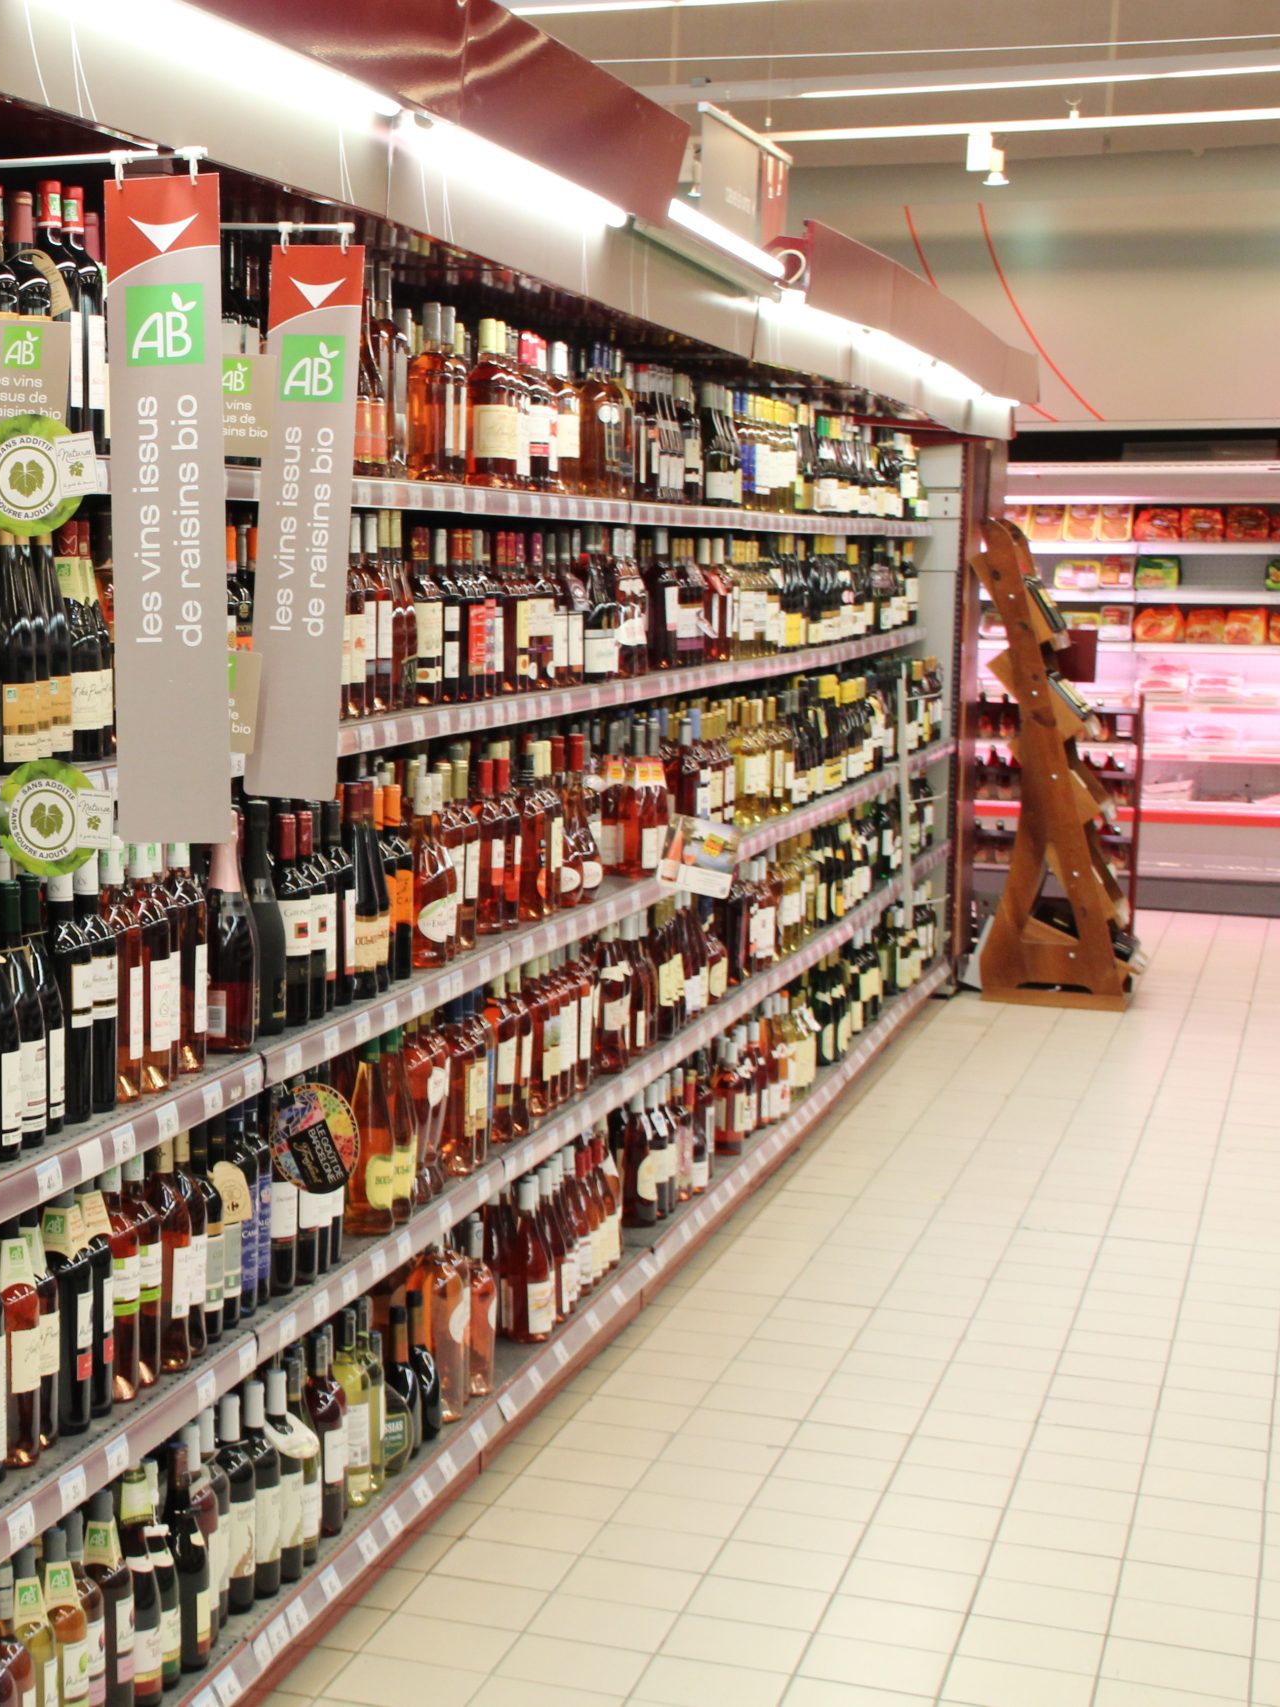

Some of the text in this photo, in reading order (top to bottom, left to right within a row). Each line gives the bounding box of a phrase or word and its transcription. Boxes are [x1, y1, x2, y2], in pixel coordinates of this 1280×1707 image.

[131, 310, 194, 360] AB
[3, 339, 36, 366] AB
[13, 375, 43, 388] vins
[283, 356, 335, 396] AB
[29, 391, 48, 404] de
[225, 400, 252, 411] vins
[239, 413, 256, 425] de
[248, 427, 269, 438] bio
[132, 394, 163, 643] les vins issus
[171, 393, 203, 648] de raisins bio
[269, 425, 303, 632] les vins issus
[301, 426, 335, 638] de raisins bio
[21, 781, 44, 796] SANS
[15, 832, 39, 858] SOUFRE
[307, 1129, 336, 1183] BARCELONE
[316, 1123, 327, 1139] LE
[332, 1164, 345, 1179] DE
